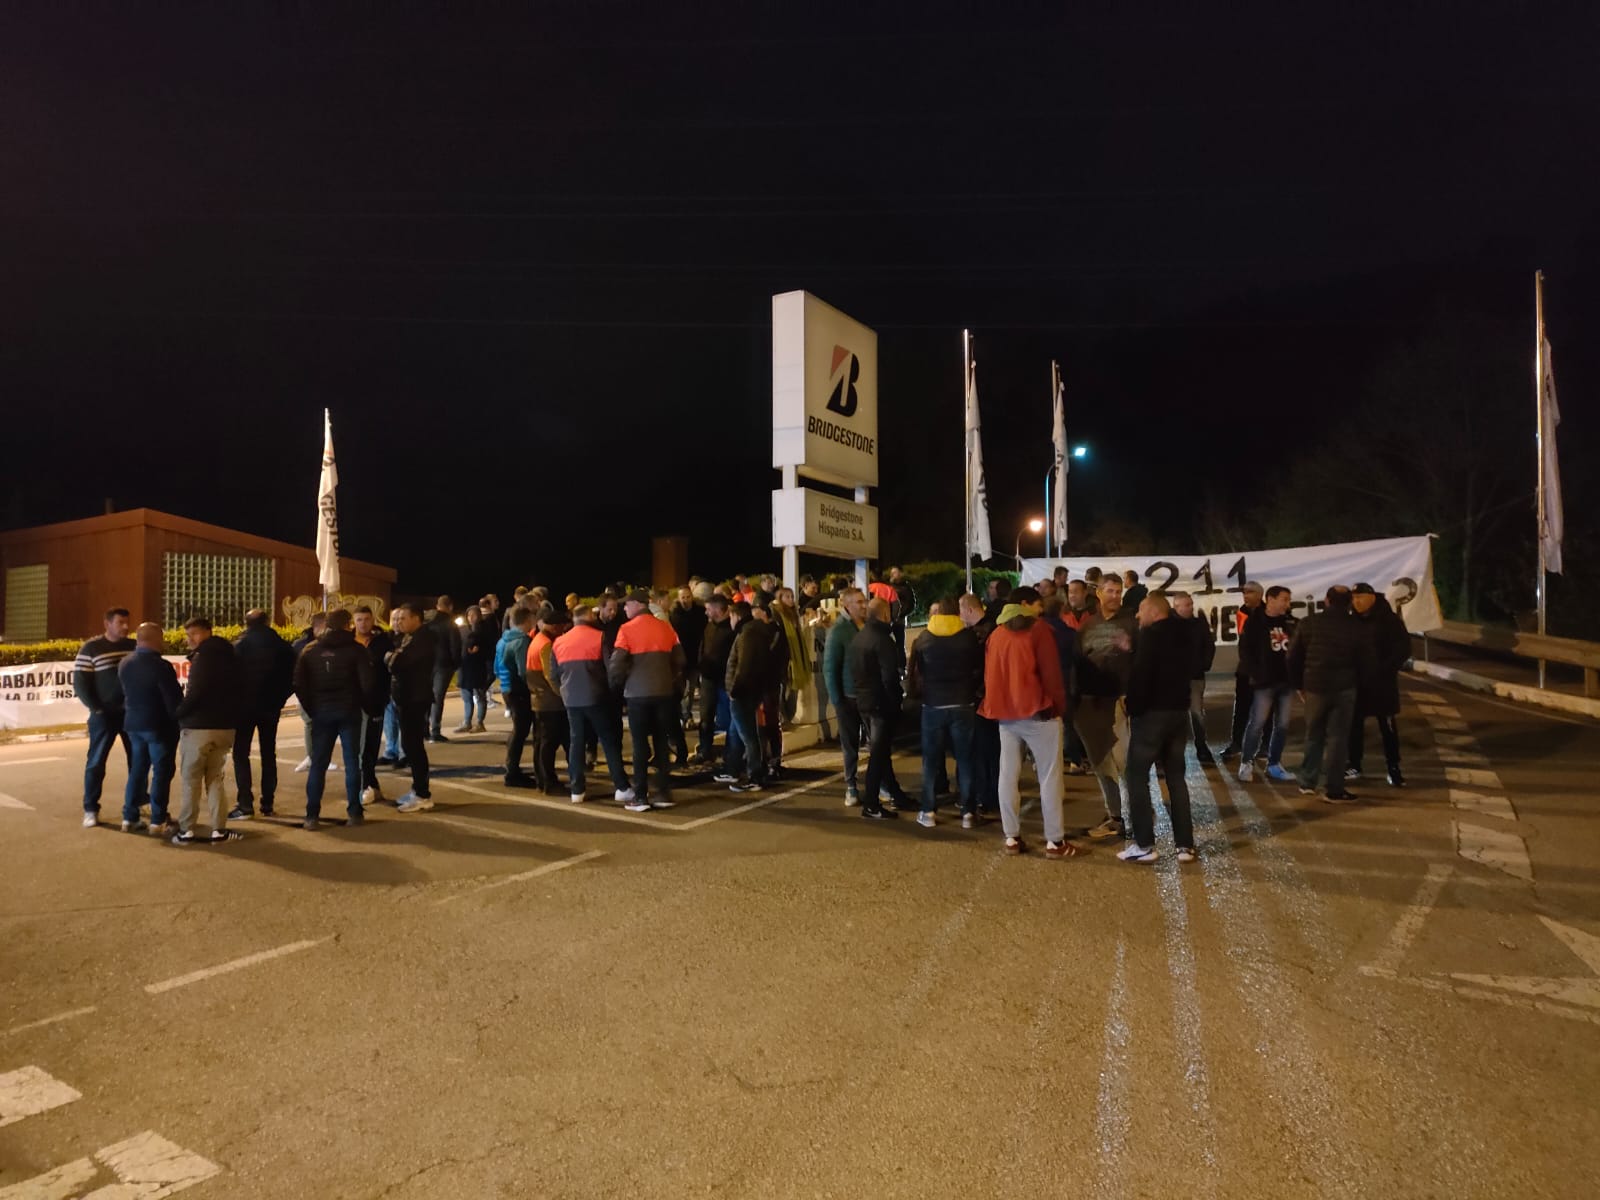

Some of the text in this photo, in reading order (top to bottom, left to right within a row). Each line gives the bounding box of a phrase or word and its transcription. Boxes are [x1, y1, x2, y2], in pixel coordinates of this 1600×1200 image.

[808, 415, 875, 455] BRIDGESTONE
[820, 503, 863, 525] Bridgestone
[818, 520, 865, 542] Hispania S.A.
[1144, 556, 1247, 596] 211
